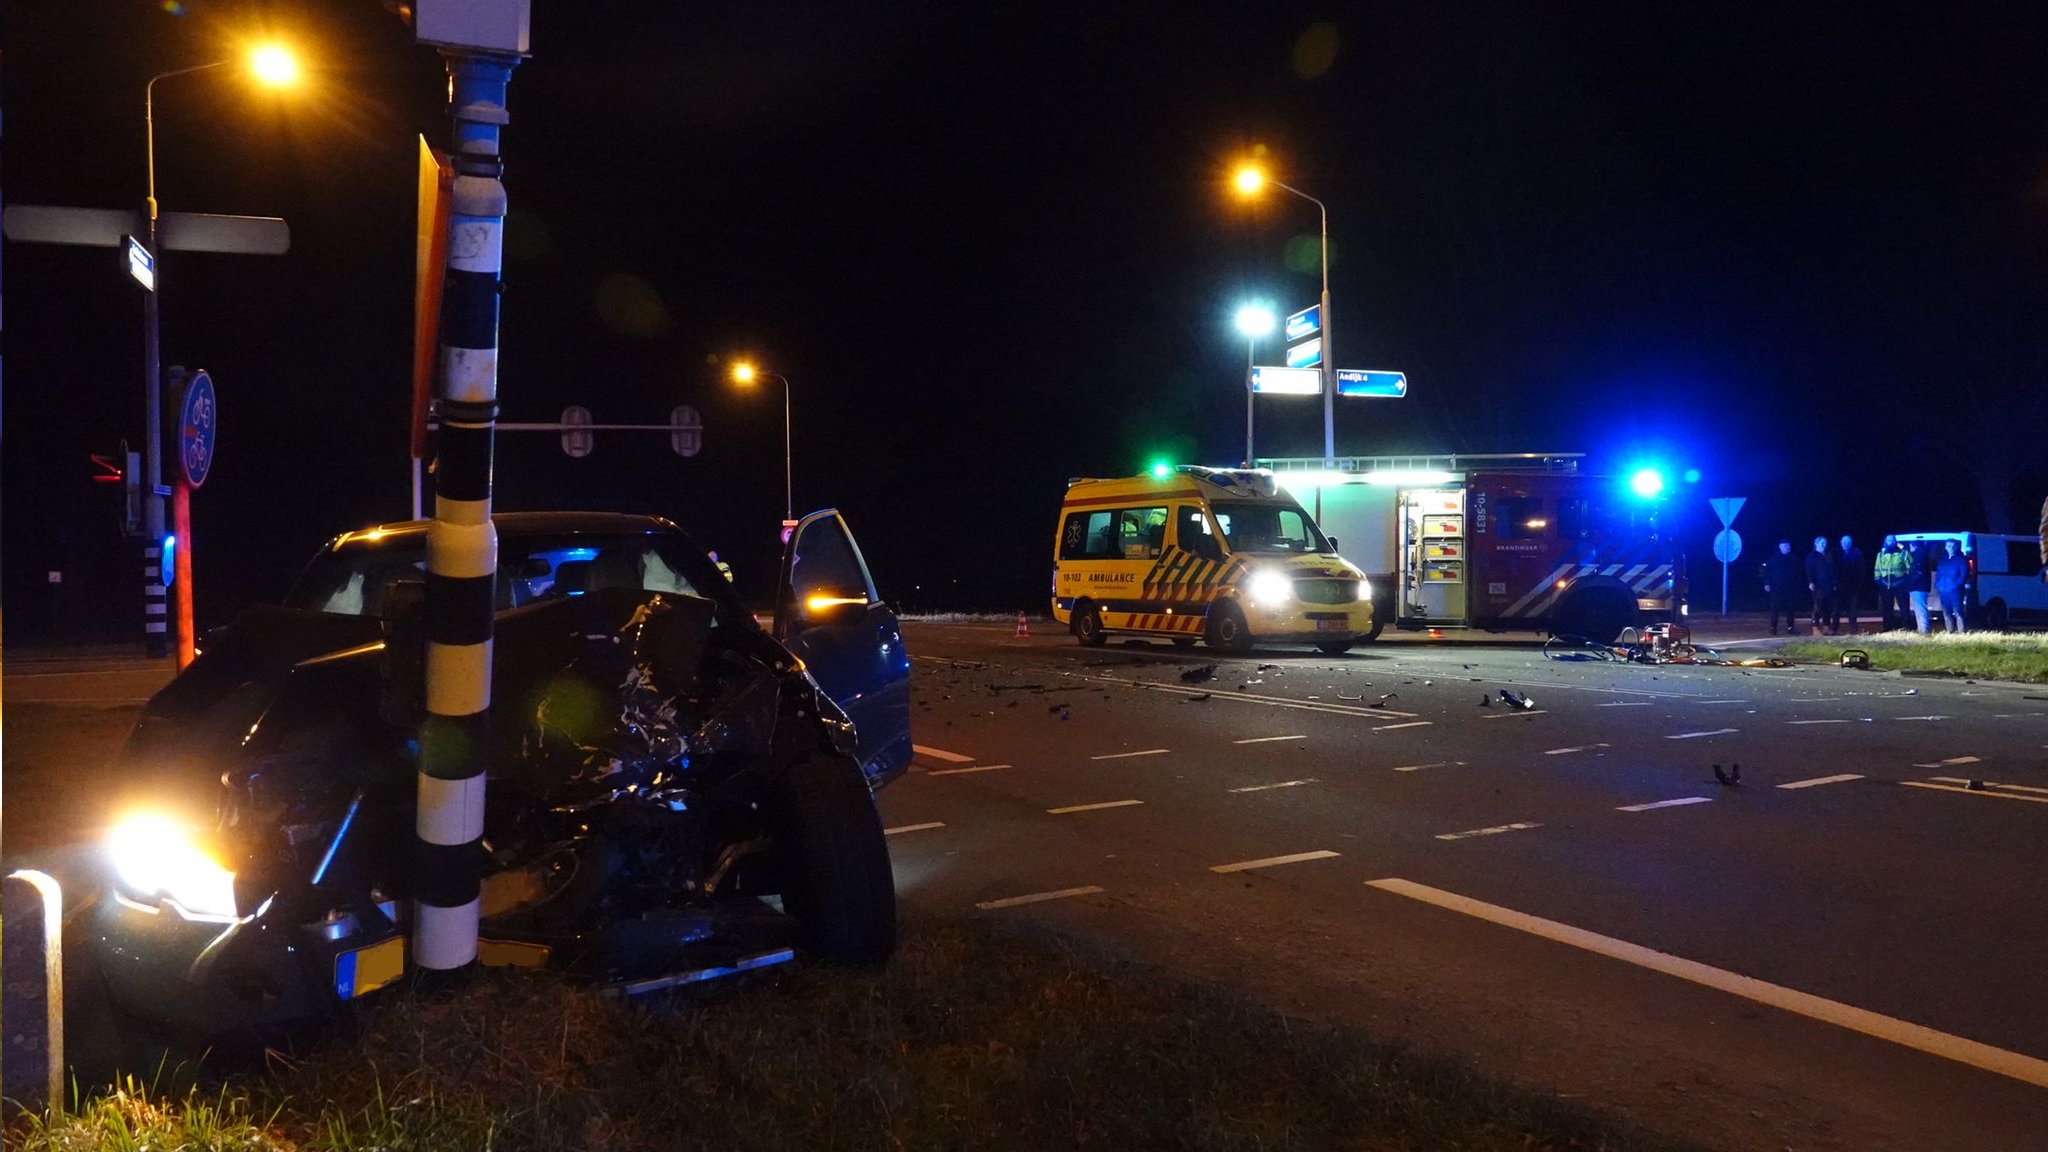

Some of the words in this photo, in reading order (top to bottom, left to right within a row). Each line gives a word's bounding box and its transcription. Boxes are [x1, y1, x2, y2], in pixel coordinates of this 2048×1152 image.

[1339, 372, 1363, 383] Andijk
[1476, 492, 1486, 533] 10-5831
[1088, 573, 1135, 583] AMBULANCE
[338, 982, 349, 993] NL
